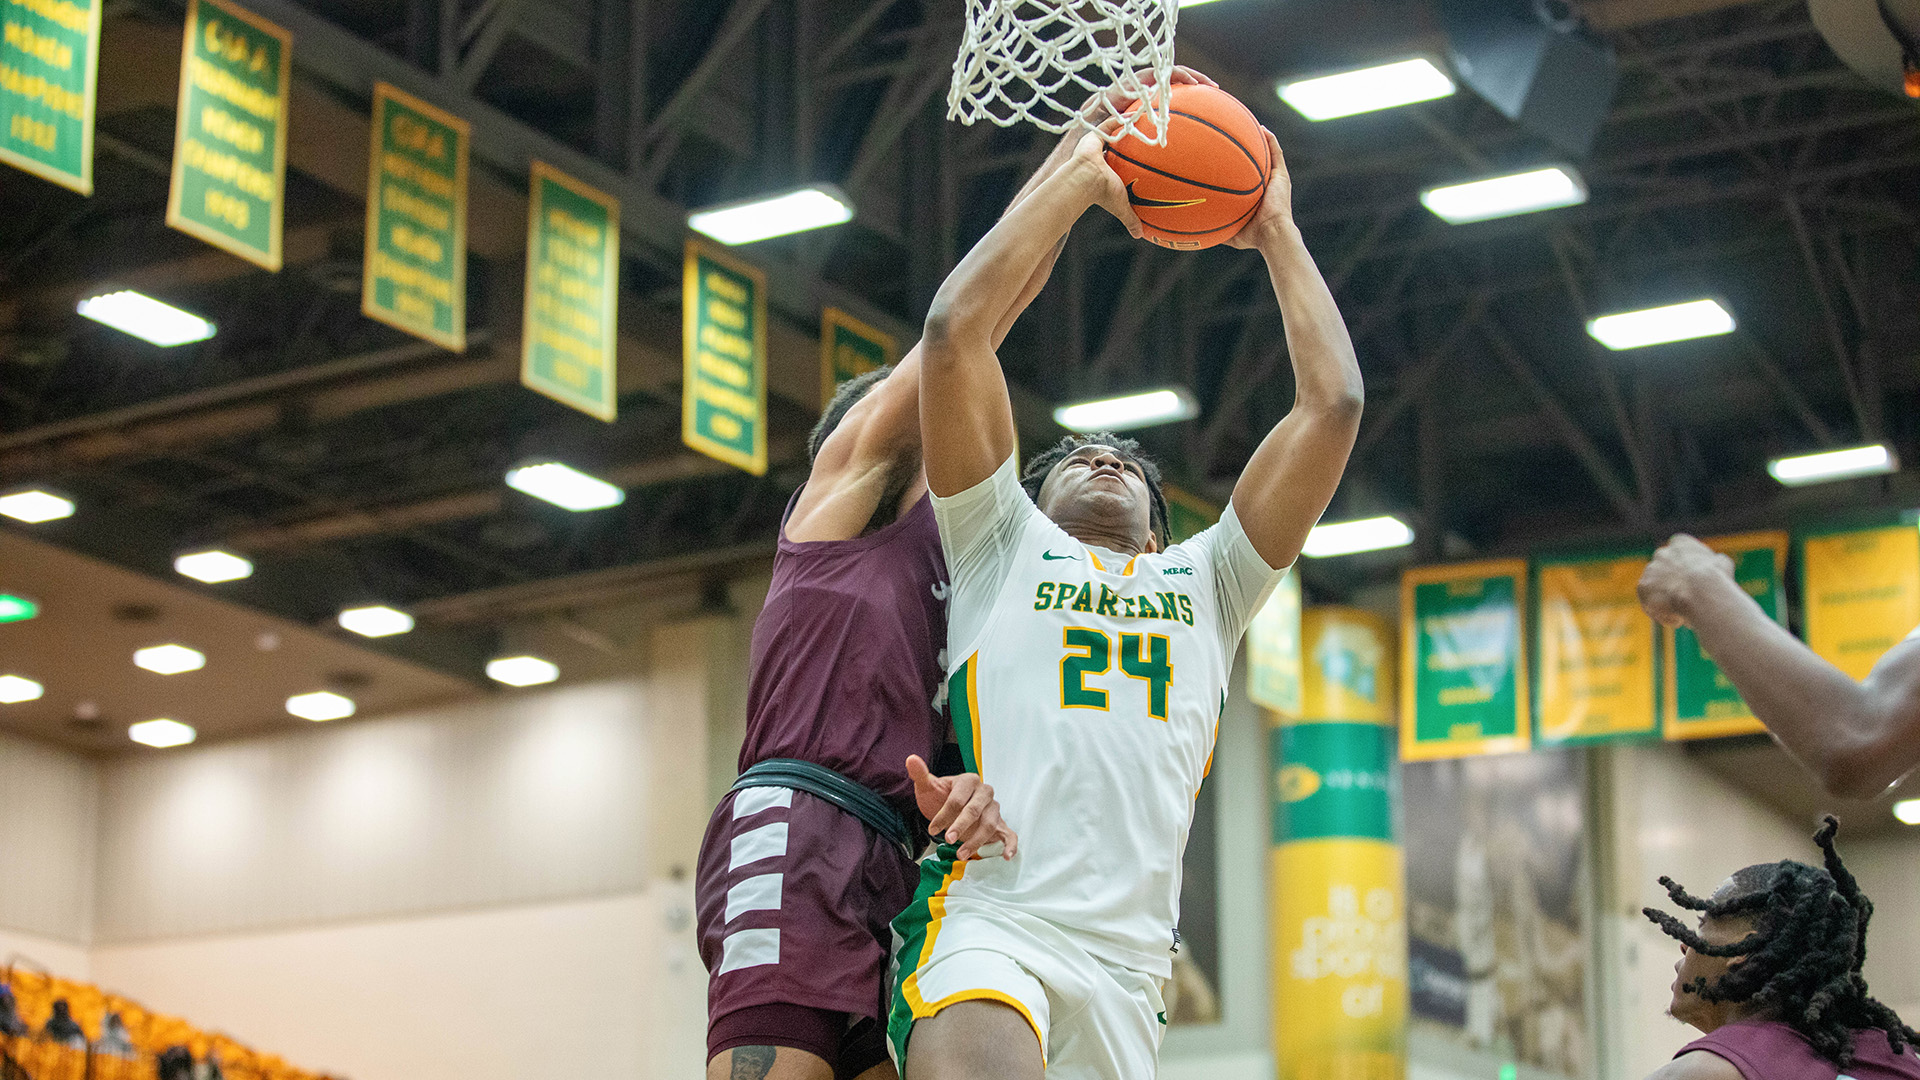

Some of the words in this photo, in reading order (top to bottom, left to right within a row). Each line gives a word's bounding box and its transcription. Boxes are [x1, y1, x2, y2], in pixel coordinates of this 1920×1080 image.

[1162, 566, 1193, 576] MEAC
[1033, 581, 1195, 627] SPARTANS
[1059, 626, 1174, 722] 24
